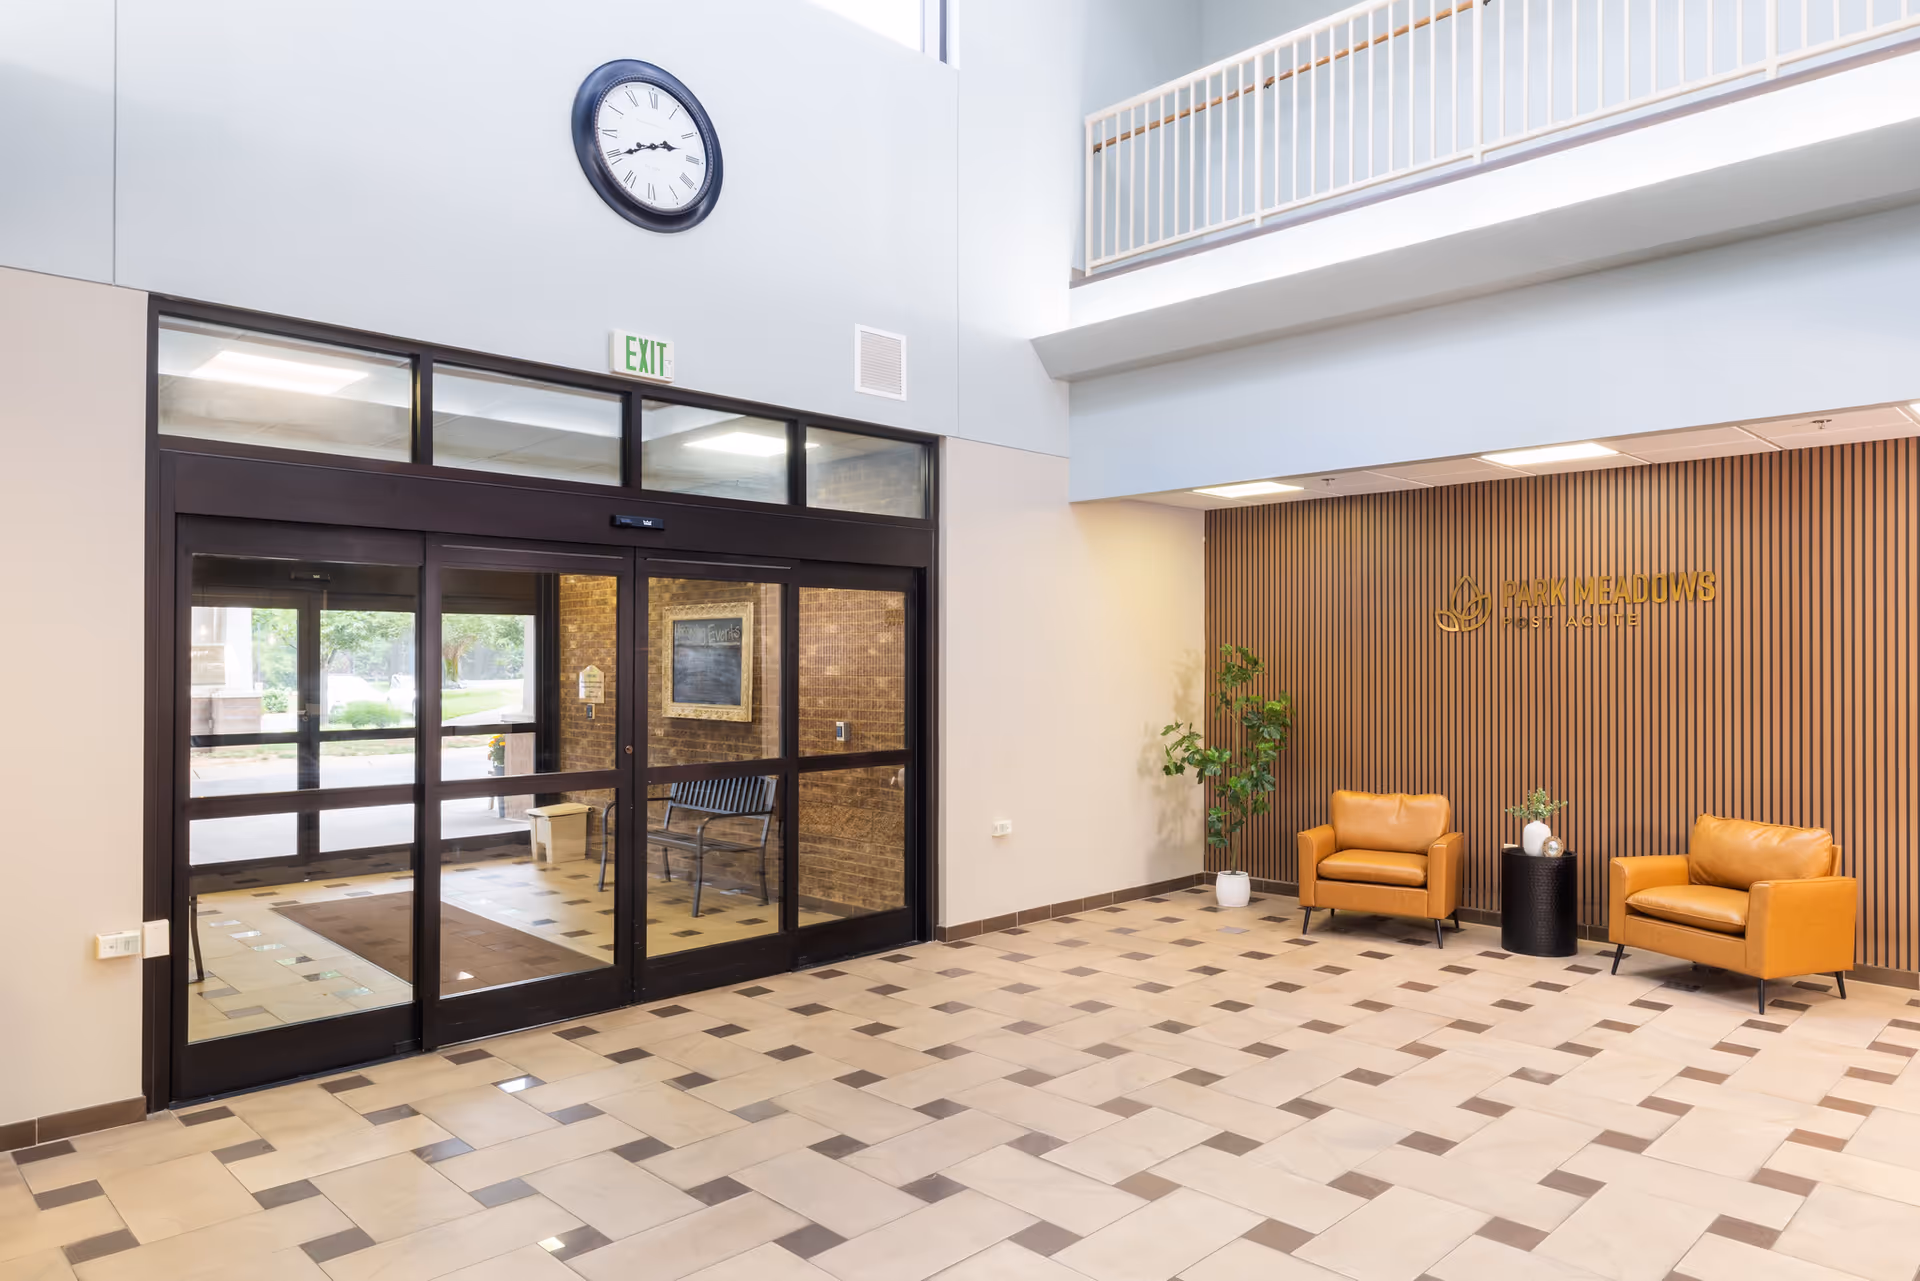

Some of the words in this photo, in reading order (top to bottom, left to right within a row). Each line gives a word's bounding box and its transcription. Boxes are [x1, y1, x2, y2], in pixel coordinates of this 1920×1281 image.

[626, 335, 667, 376] EXIT
[1503, 577, 1567, 608] PARK
[1574, 571, 1716, 606] MEADOWS
[708, 623, 741, 643] Events
[1503, 615, 1553, 629] POST
[1566, 613, 1640, 627] ACUTE
